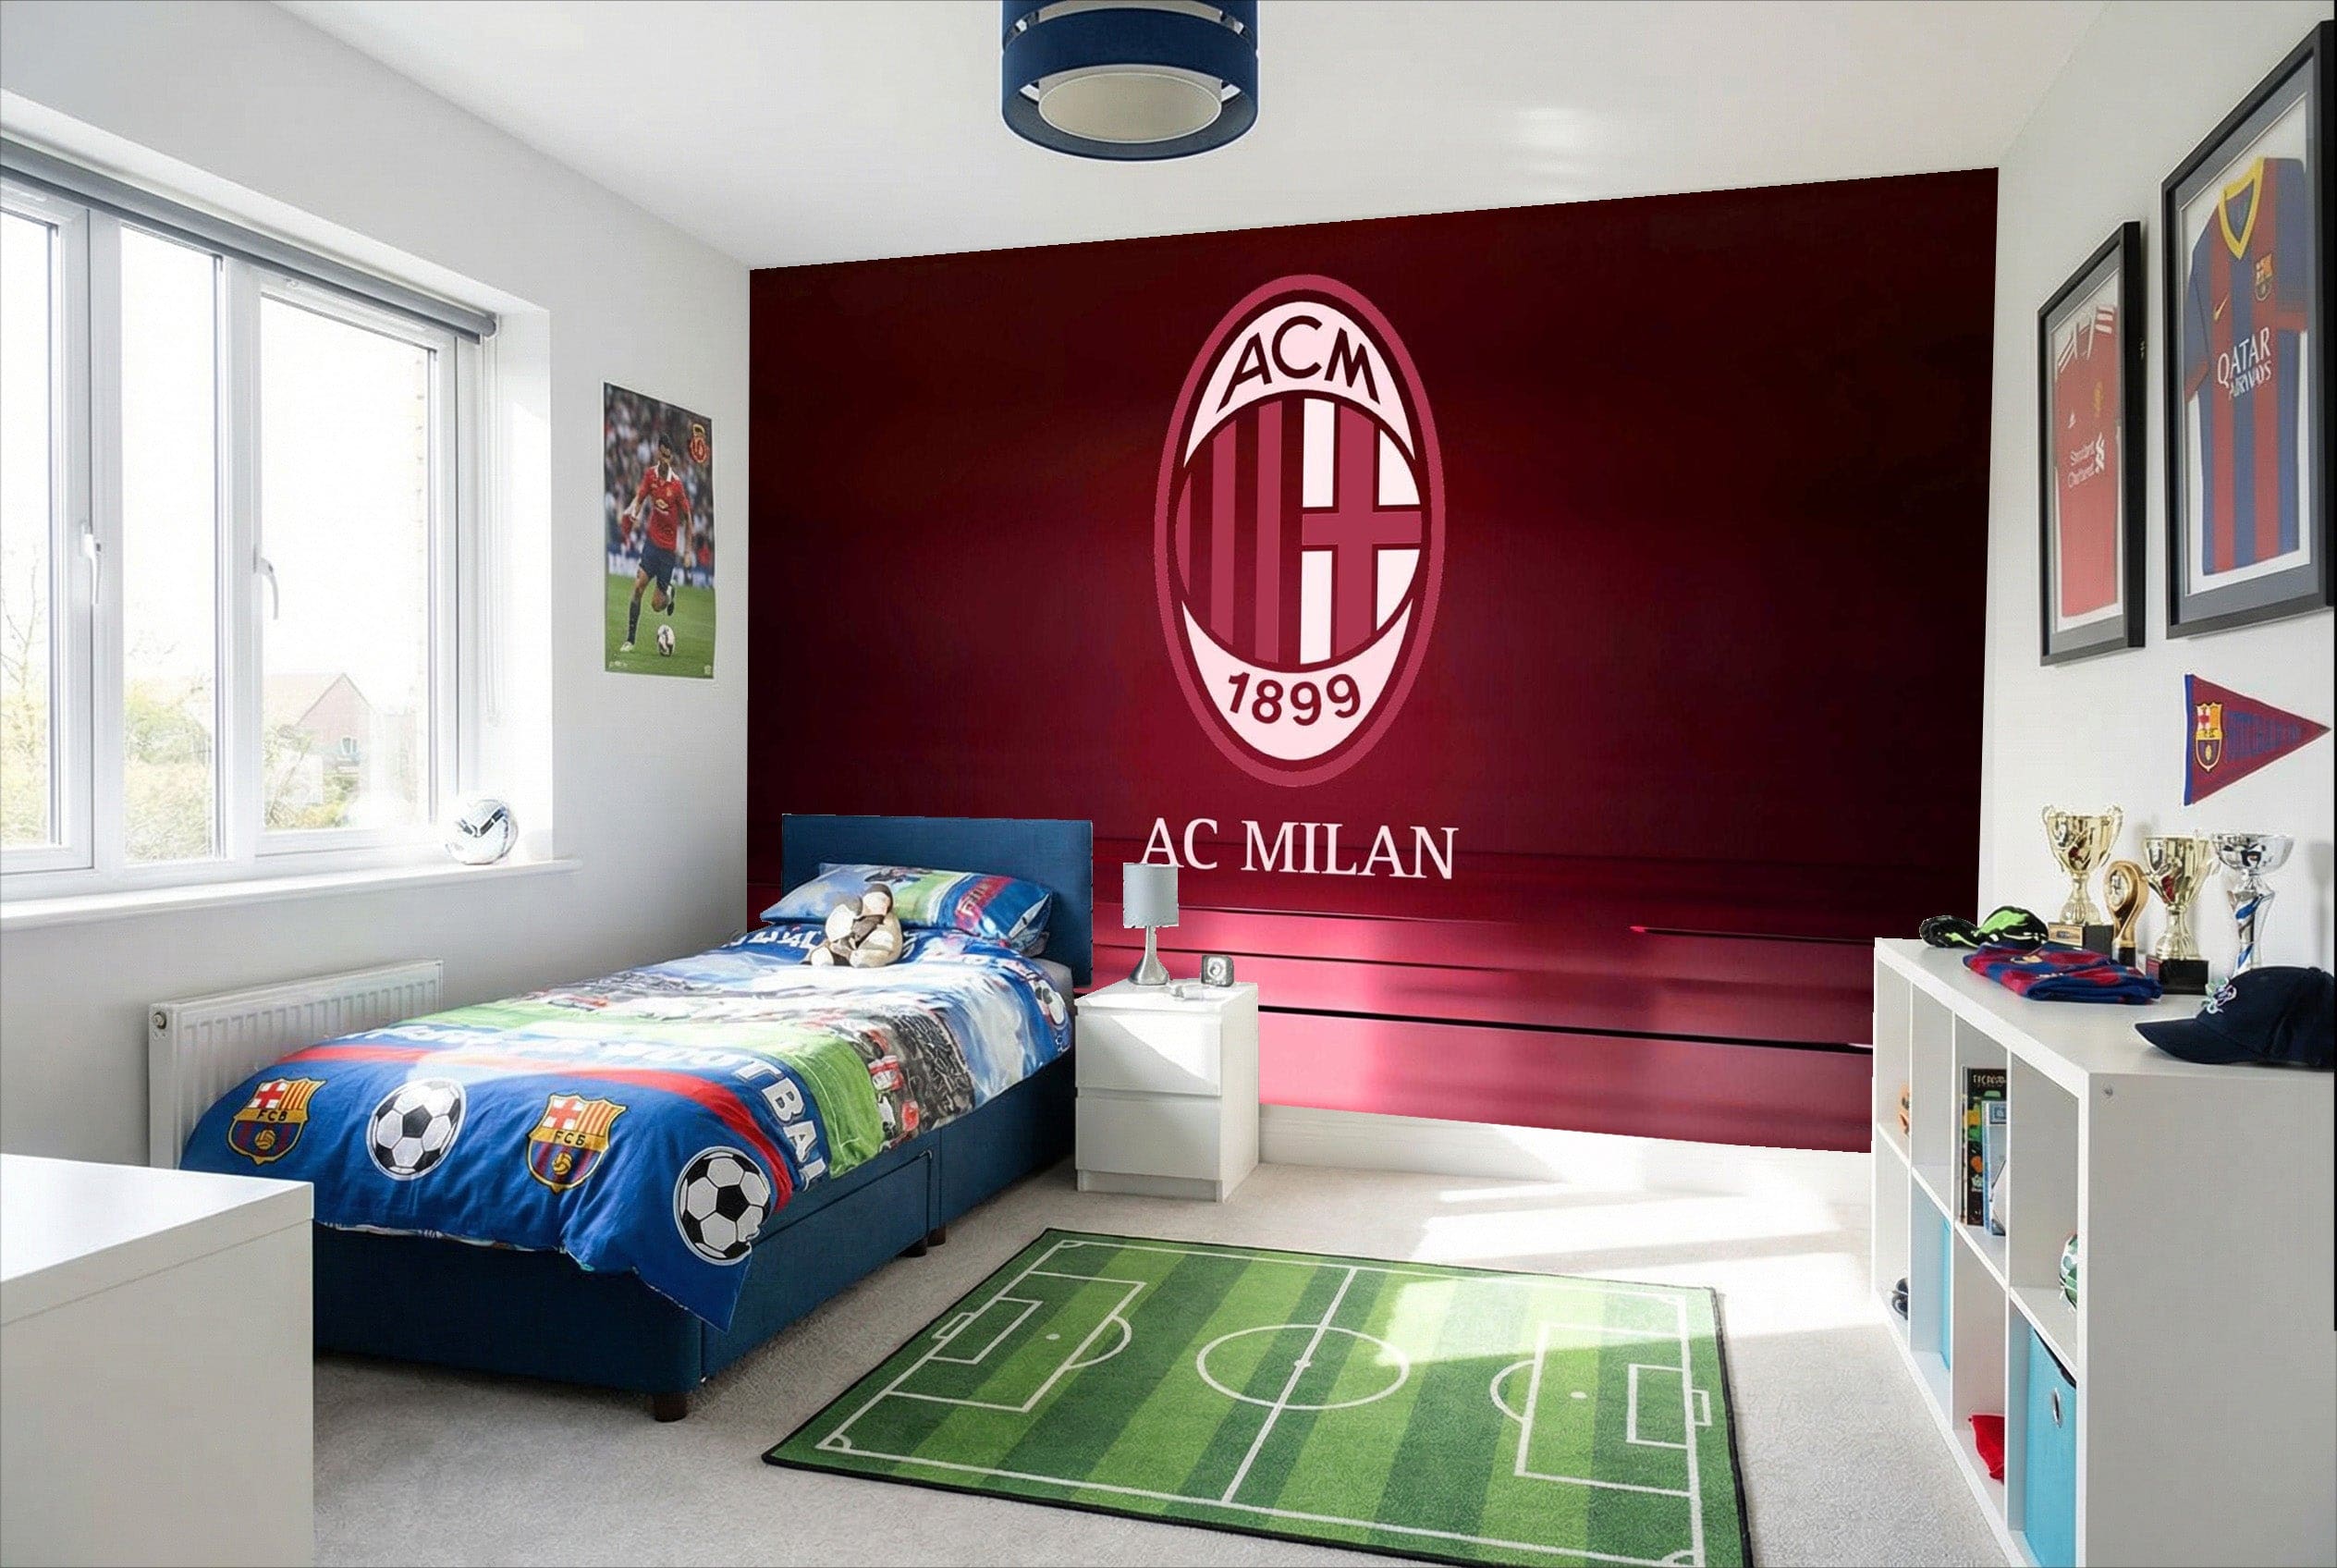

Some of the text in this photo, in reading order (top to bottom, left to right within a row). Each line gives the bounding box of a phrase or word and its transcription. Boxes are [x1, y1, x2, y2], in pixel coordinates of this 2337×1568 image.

[1217, 315, 1381, 414] ACM
[2218, 326, 2271, 389] QATAR
[1227, 672, 1362, 726] 1899
[1140, 817, 1459, 880] AC MILAN
[256, 1109, 289, 1122] FCB
[554, 1130, 586, 1146] FCB
